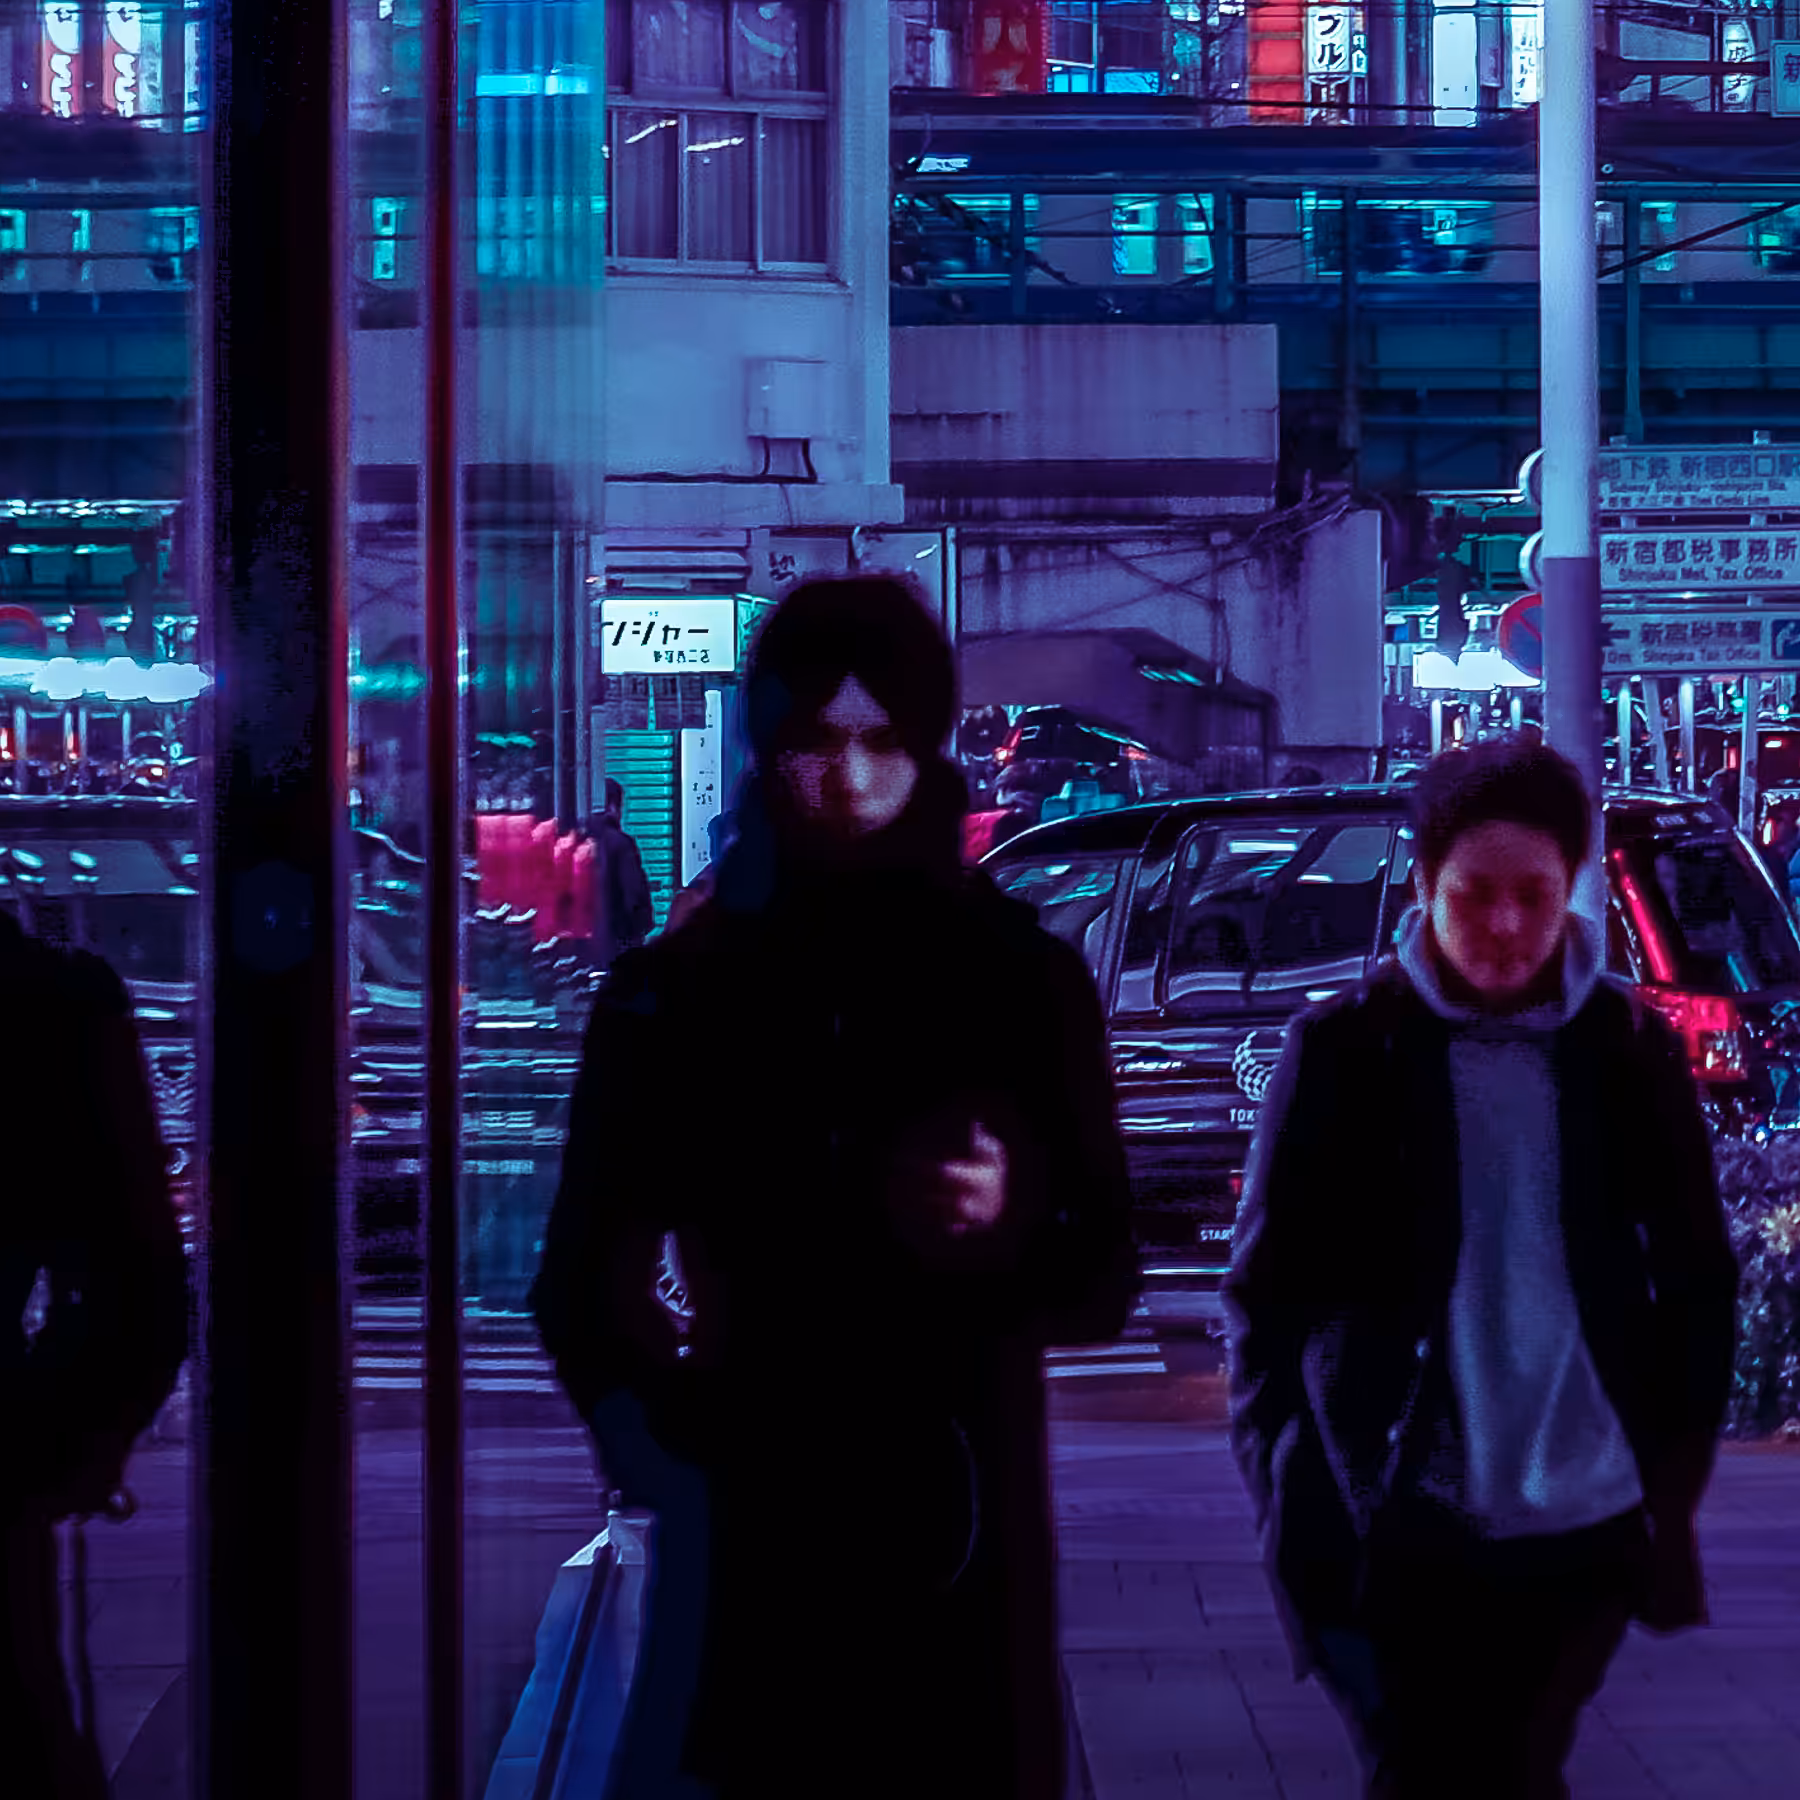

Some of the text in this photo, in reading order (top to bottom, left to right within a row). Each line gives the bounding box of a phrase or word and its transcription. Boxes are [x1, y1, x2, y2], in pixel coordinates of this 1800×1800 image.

[1605, 537, 1797, 565] 新宿都税事務所
